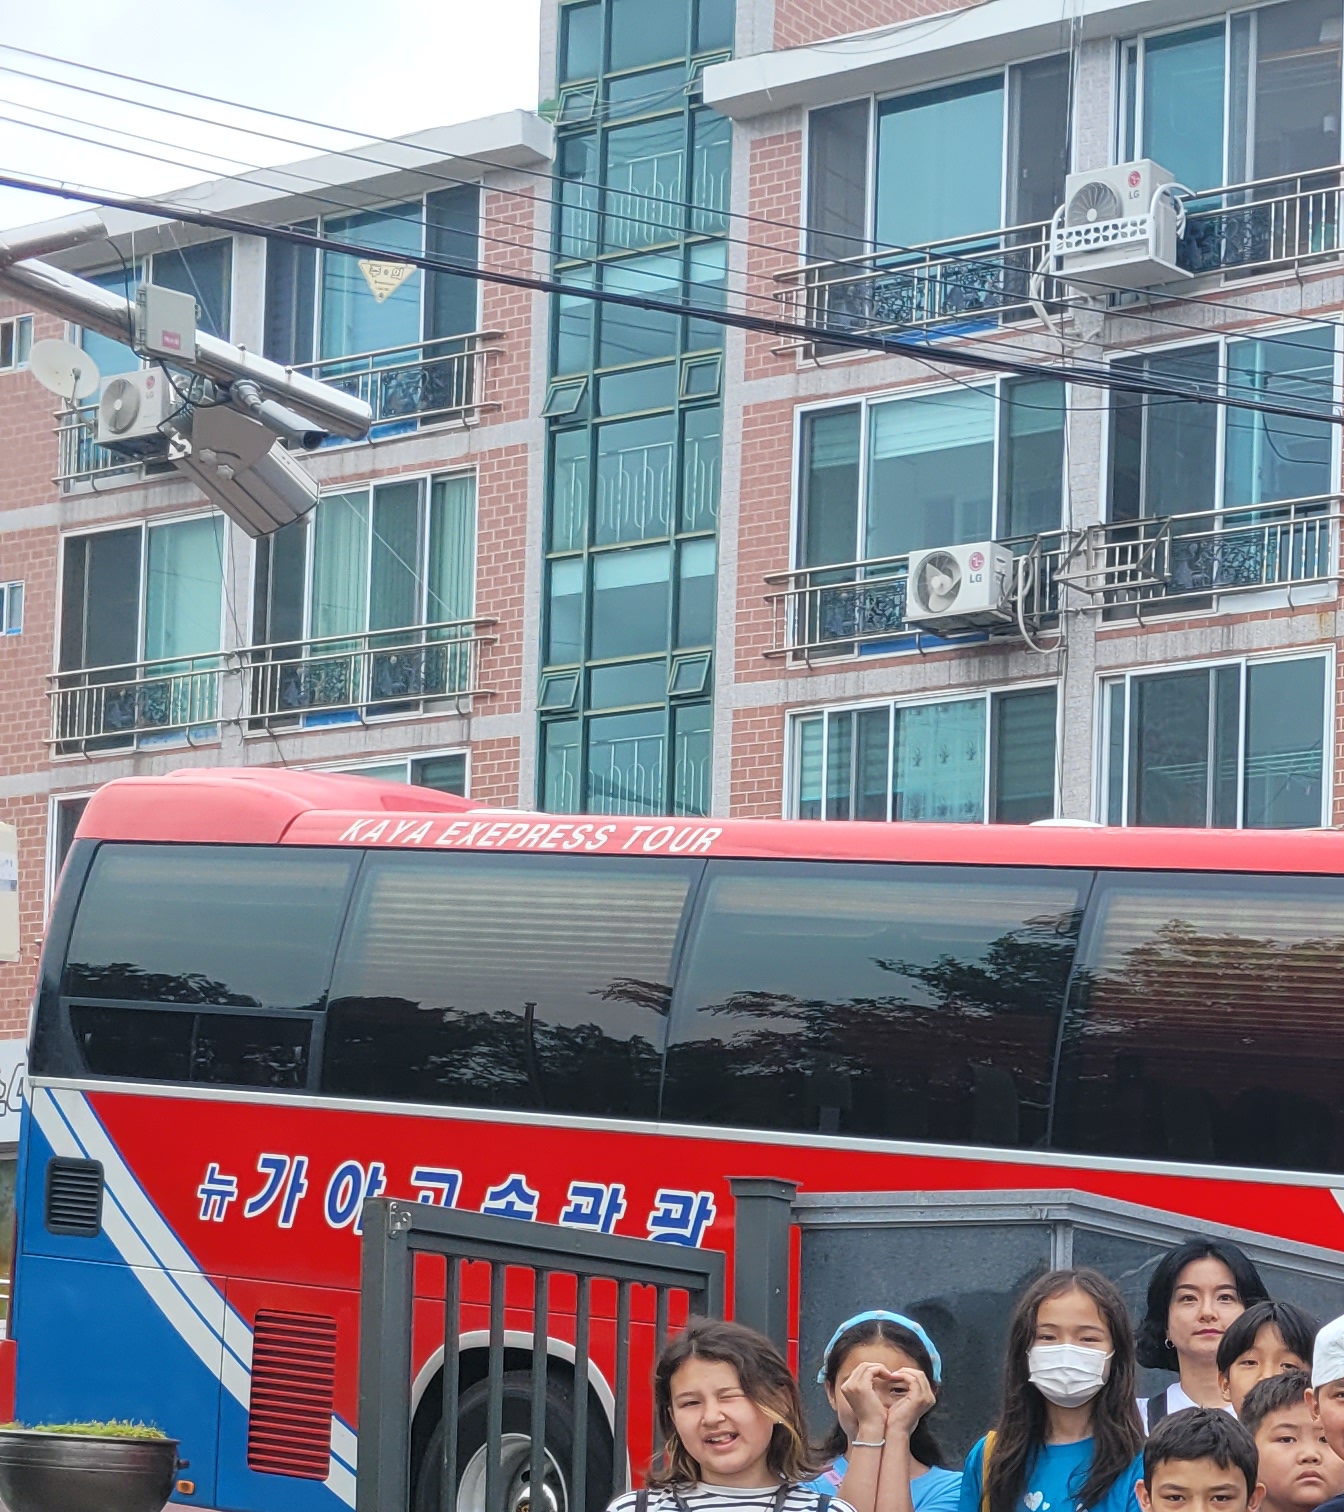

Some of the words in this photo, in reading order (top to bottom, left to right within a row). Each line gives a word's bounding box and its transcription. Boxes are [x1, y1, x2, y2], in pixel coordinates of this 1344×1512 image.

[1129, 190, 1140, 199] LG
[970, 574, 982, 584] LG
[338, 818, 431, 844] KAYA
[434, 821, 615, 850] EXEPRESS
[621, 825, 724, 853] TOUR
